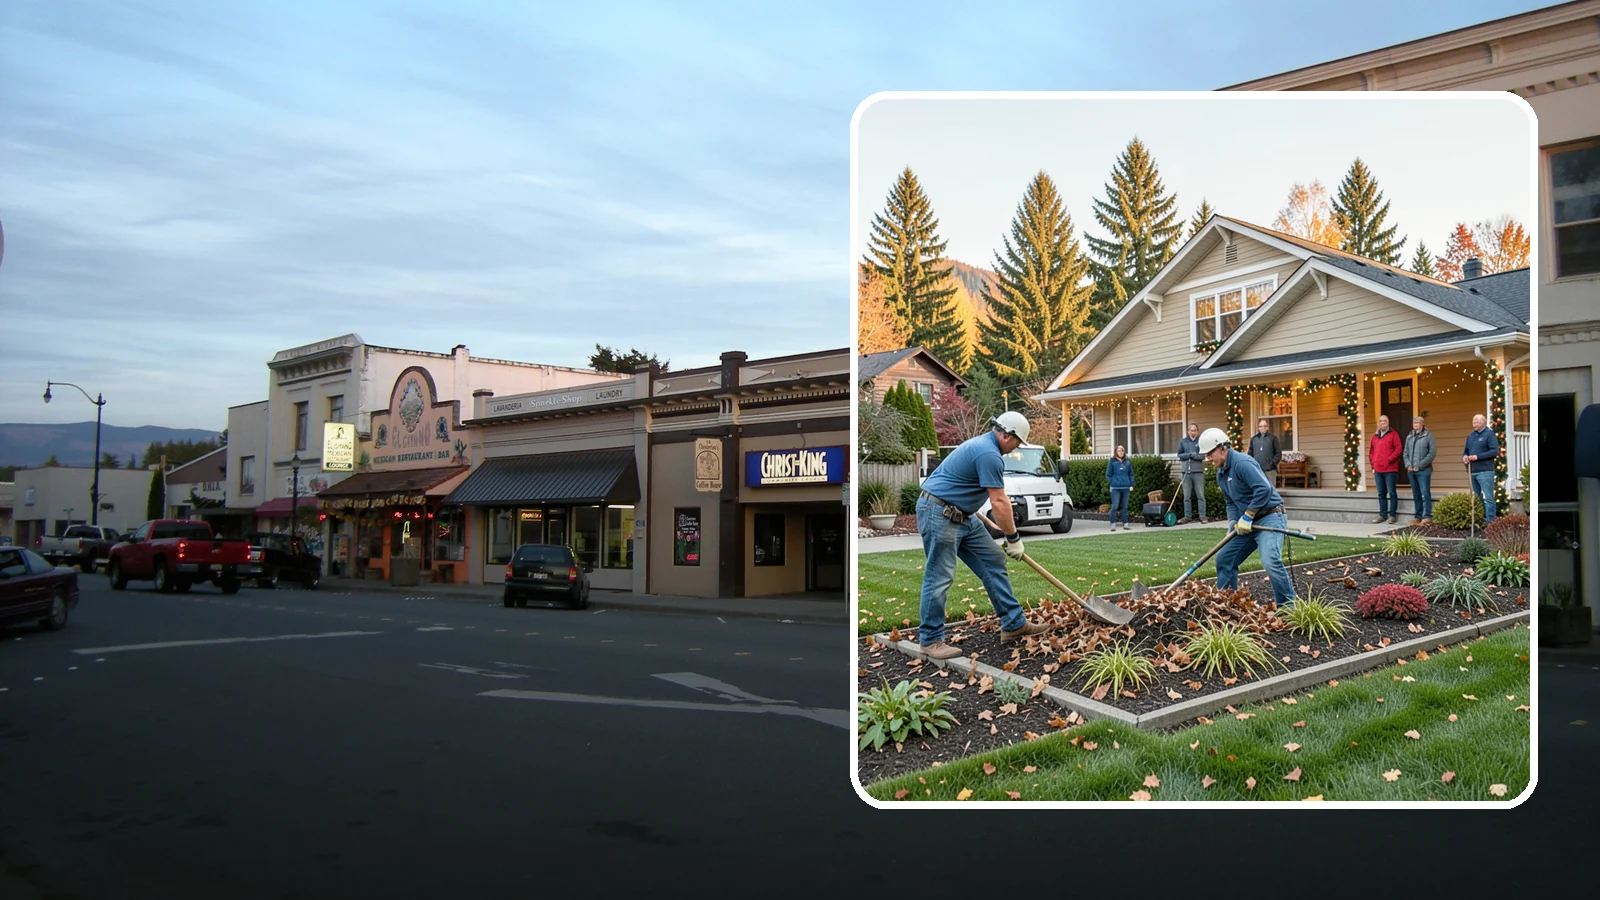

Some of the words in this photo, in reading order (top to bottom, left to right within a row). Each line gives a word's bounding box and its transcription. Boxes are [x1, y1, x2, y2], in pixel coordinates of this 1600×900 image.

[530, 397, 561, 408] Sparkle
[561, 394, 582, 405] Shop
[595, 389, 624, 400] LAUNDRY
[493, 402, 522, 413] LAVANDERIA
[374, 455, 396, 464] MEXICAN
[397, 451, 433, 462] RESTAURANT
[437, 450, 450, 459] BAR
[761, 452, 797, 478] CHRIST
[799, 450, 827, 476] KING
